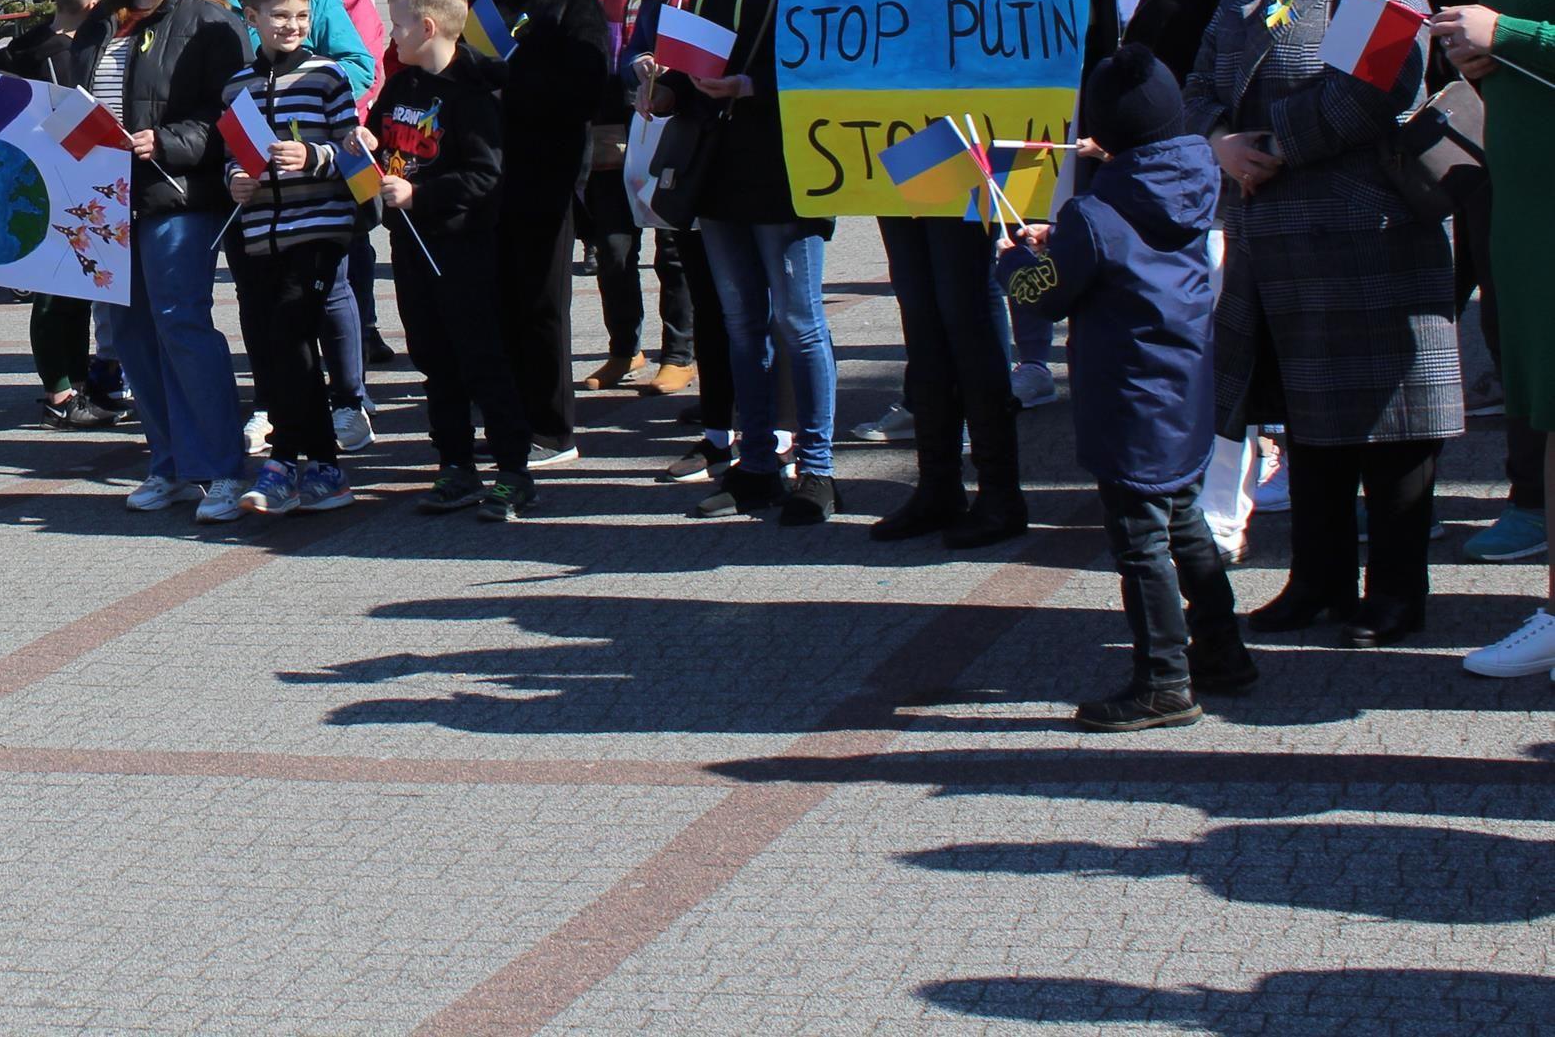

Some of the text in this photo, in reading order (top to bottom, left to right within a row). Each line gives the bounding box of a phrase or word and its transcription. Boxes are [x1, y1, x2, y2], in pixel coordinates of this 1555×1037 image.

[780, 1, 910, 69] STOP
[392, 106, 426, 125] BRAW
[806, 115, 946, 196] ST
